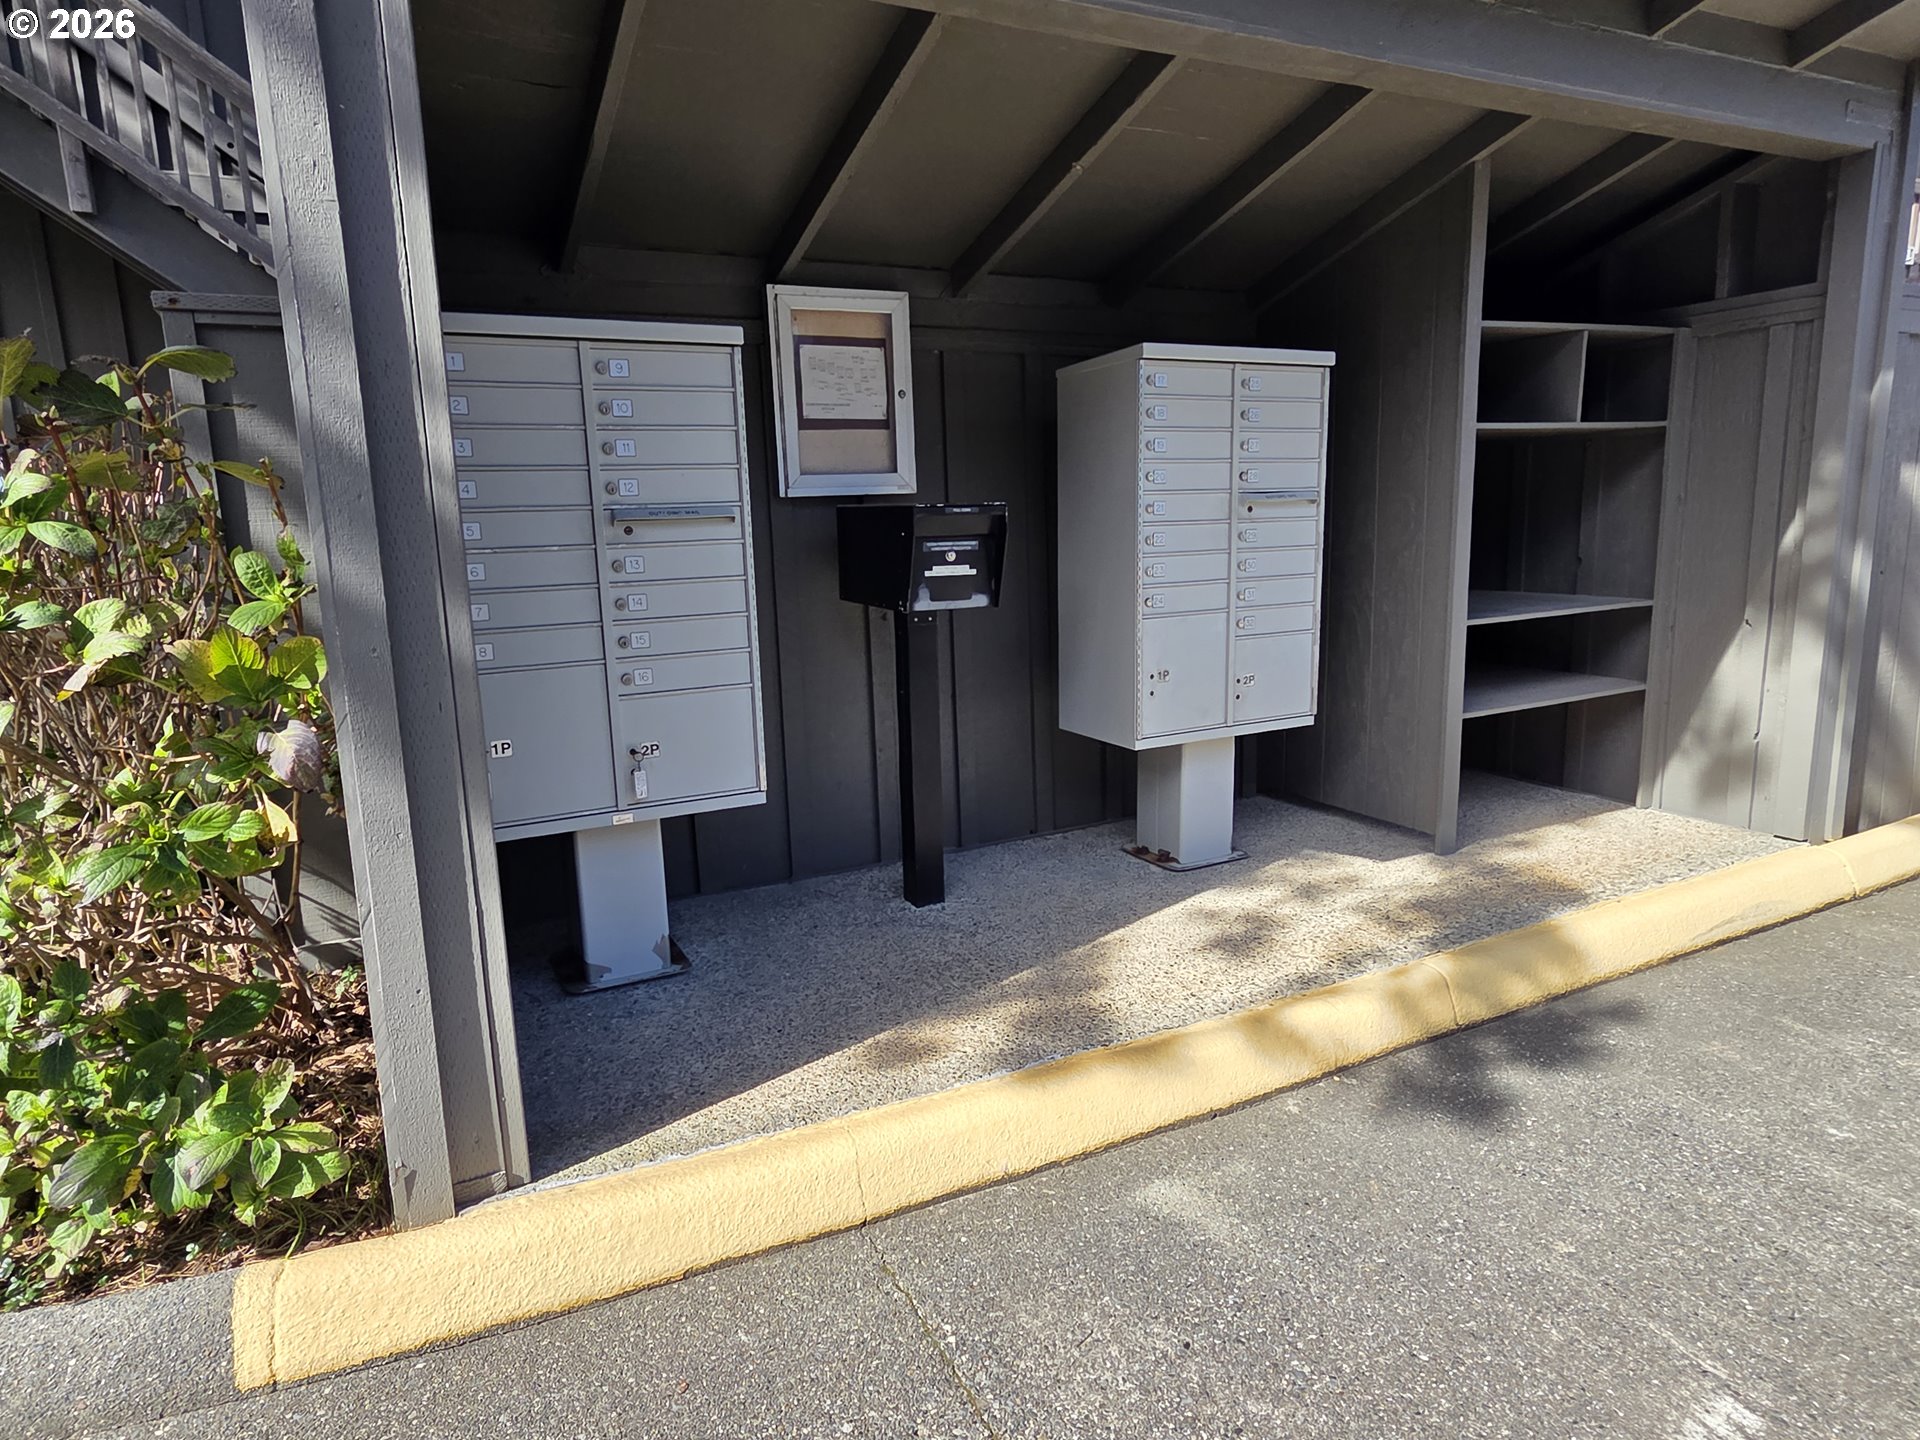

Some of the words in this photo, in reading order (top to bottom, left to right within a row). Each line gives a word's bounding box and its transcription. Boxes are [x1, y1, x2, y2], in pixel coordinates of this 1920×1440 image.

[615, 362, 623, 374] 9
[452, 399, 461, 411] 2
[616, 402, 629, 413] 10
[457, 442, 466, 453] 3
[622, 443, 630, 452] 11
[461, 484, 470, 495] 4
[623, 482, 634, 493] 12
[1155, 503, 1164, 512] 21
[466, 526, 474, 537] 5
[629, 559, 640, 570] 13
[470, 566, 479, 578] 6
[632, 597, 643, 607] 14
[475, 607, 482, 618] 7
[635, 634, 646, 645] 15
[478, 647, 487, 658] 8
[638, 671, 649, 682] 16
[1157, 670, 1170, 681] 1P
[1243, 674, 1255, 685] 2P
[490, 742, 512, 756] 1P
[640, 743, 660, 756] 2P
